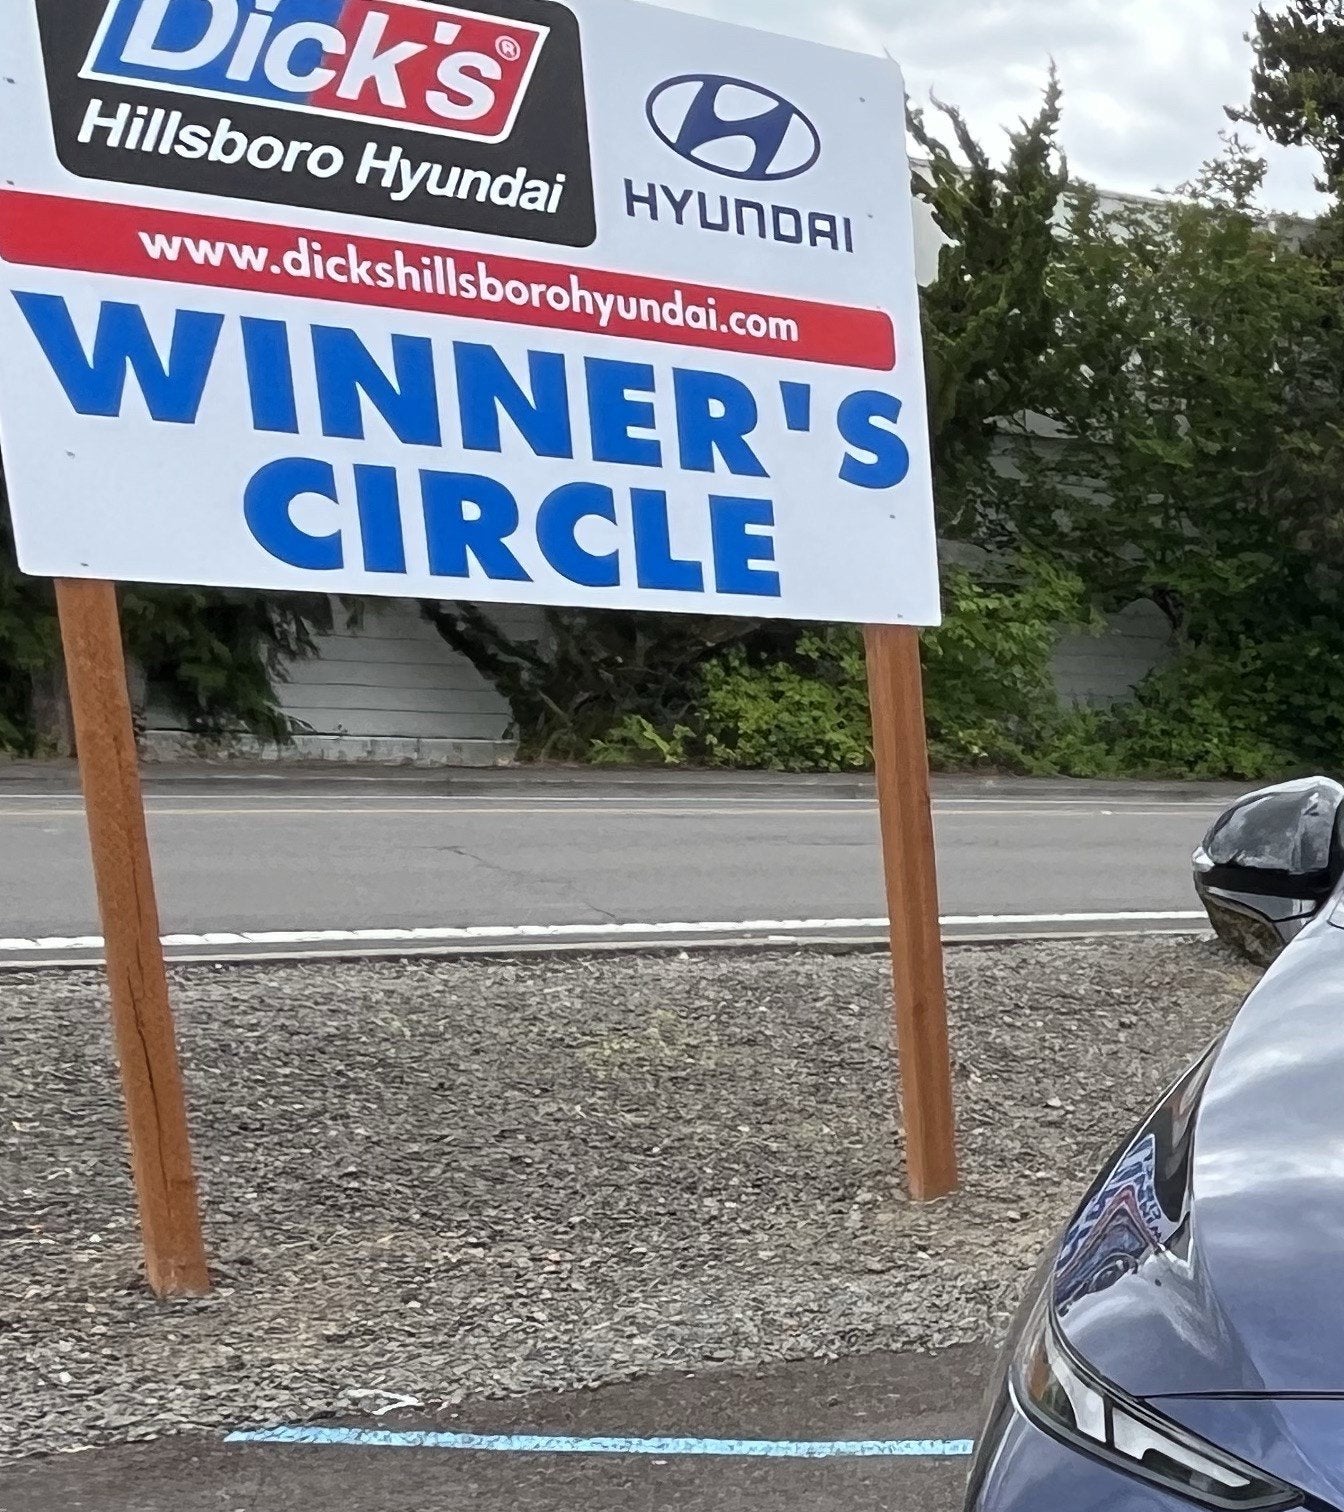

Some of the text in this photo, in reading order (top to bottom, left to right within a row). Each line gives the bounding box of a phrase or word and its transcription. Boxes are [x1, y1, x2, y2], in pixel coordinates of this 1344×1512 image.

[119, 0, 503, 121] Dick's
[77, 98, 566, 214] Hillsboro Hyundai
[623, 177, 855, 254] HYUNDAI
[138, 226, 799, 343] www.dickshillsborohyundai.com
[10, 289, 910, 490] WINNER'S
[243, 456, 782, 598] CIRCLE
